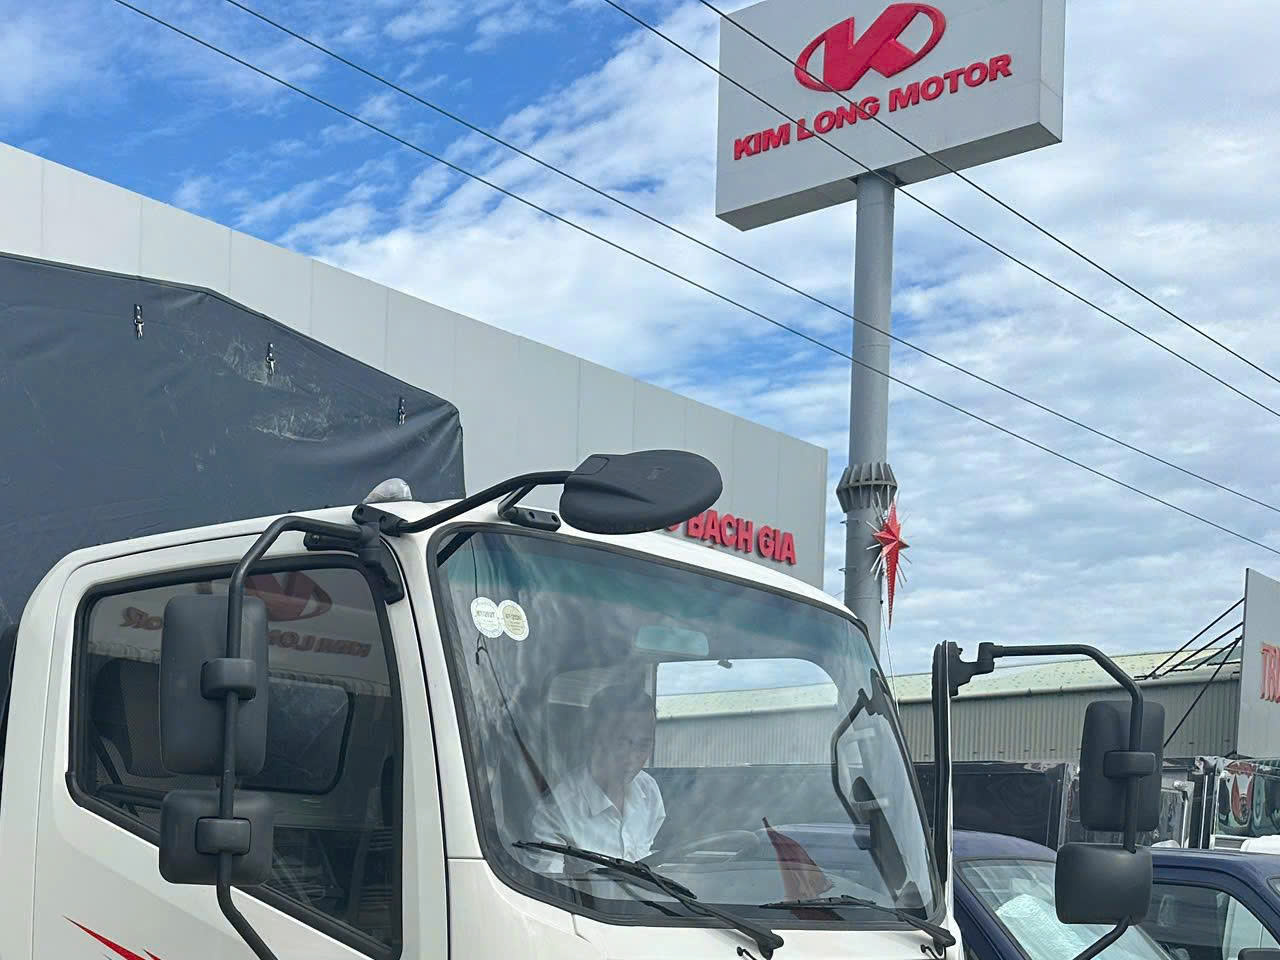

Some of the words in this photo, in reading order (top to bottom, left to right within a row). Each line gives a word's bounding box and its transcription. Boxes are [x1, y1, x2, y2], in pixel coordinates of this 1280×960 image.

[733, 122, 791, 160] KIM
[797, 96, 881, 142] LONG
[888, 54, 1013, 113] MOTOR
[758, 525, 797, 565] GIA
